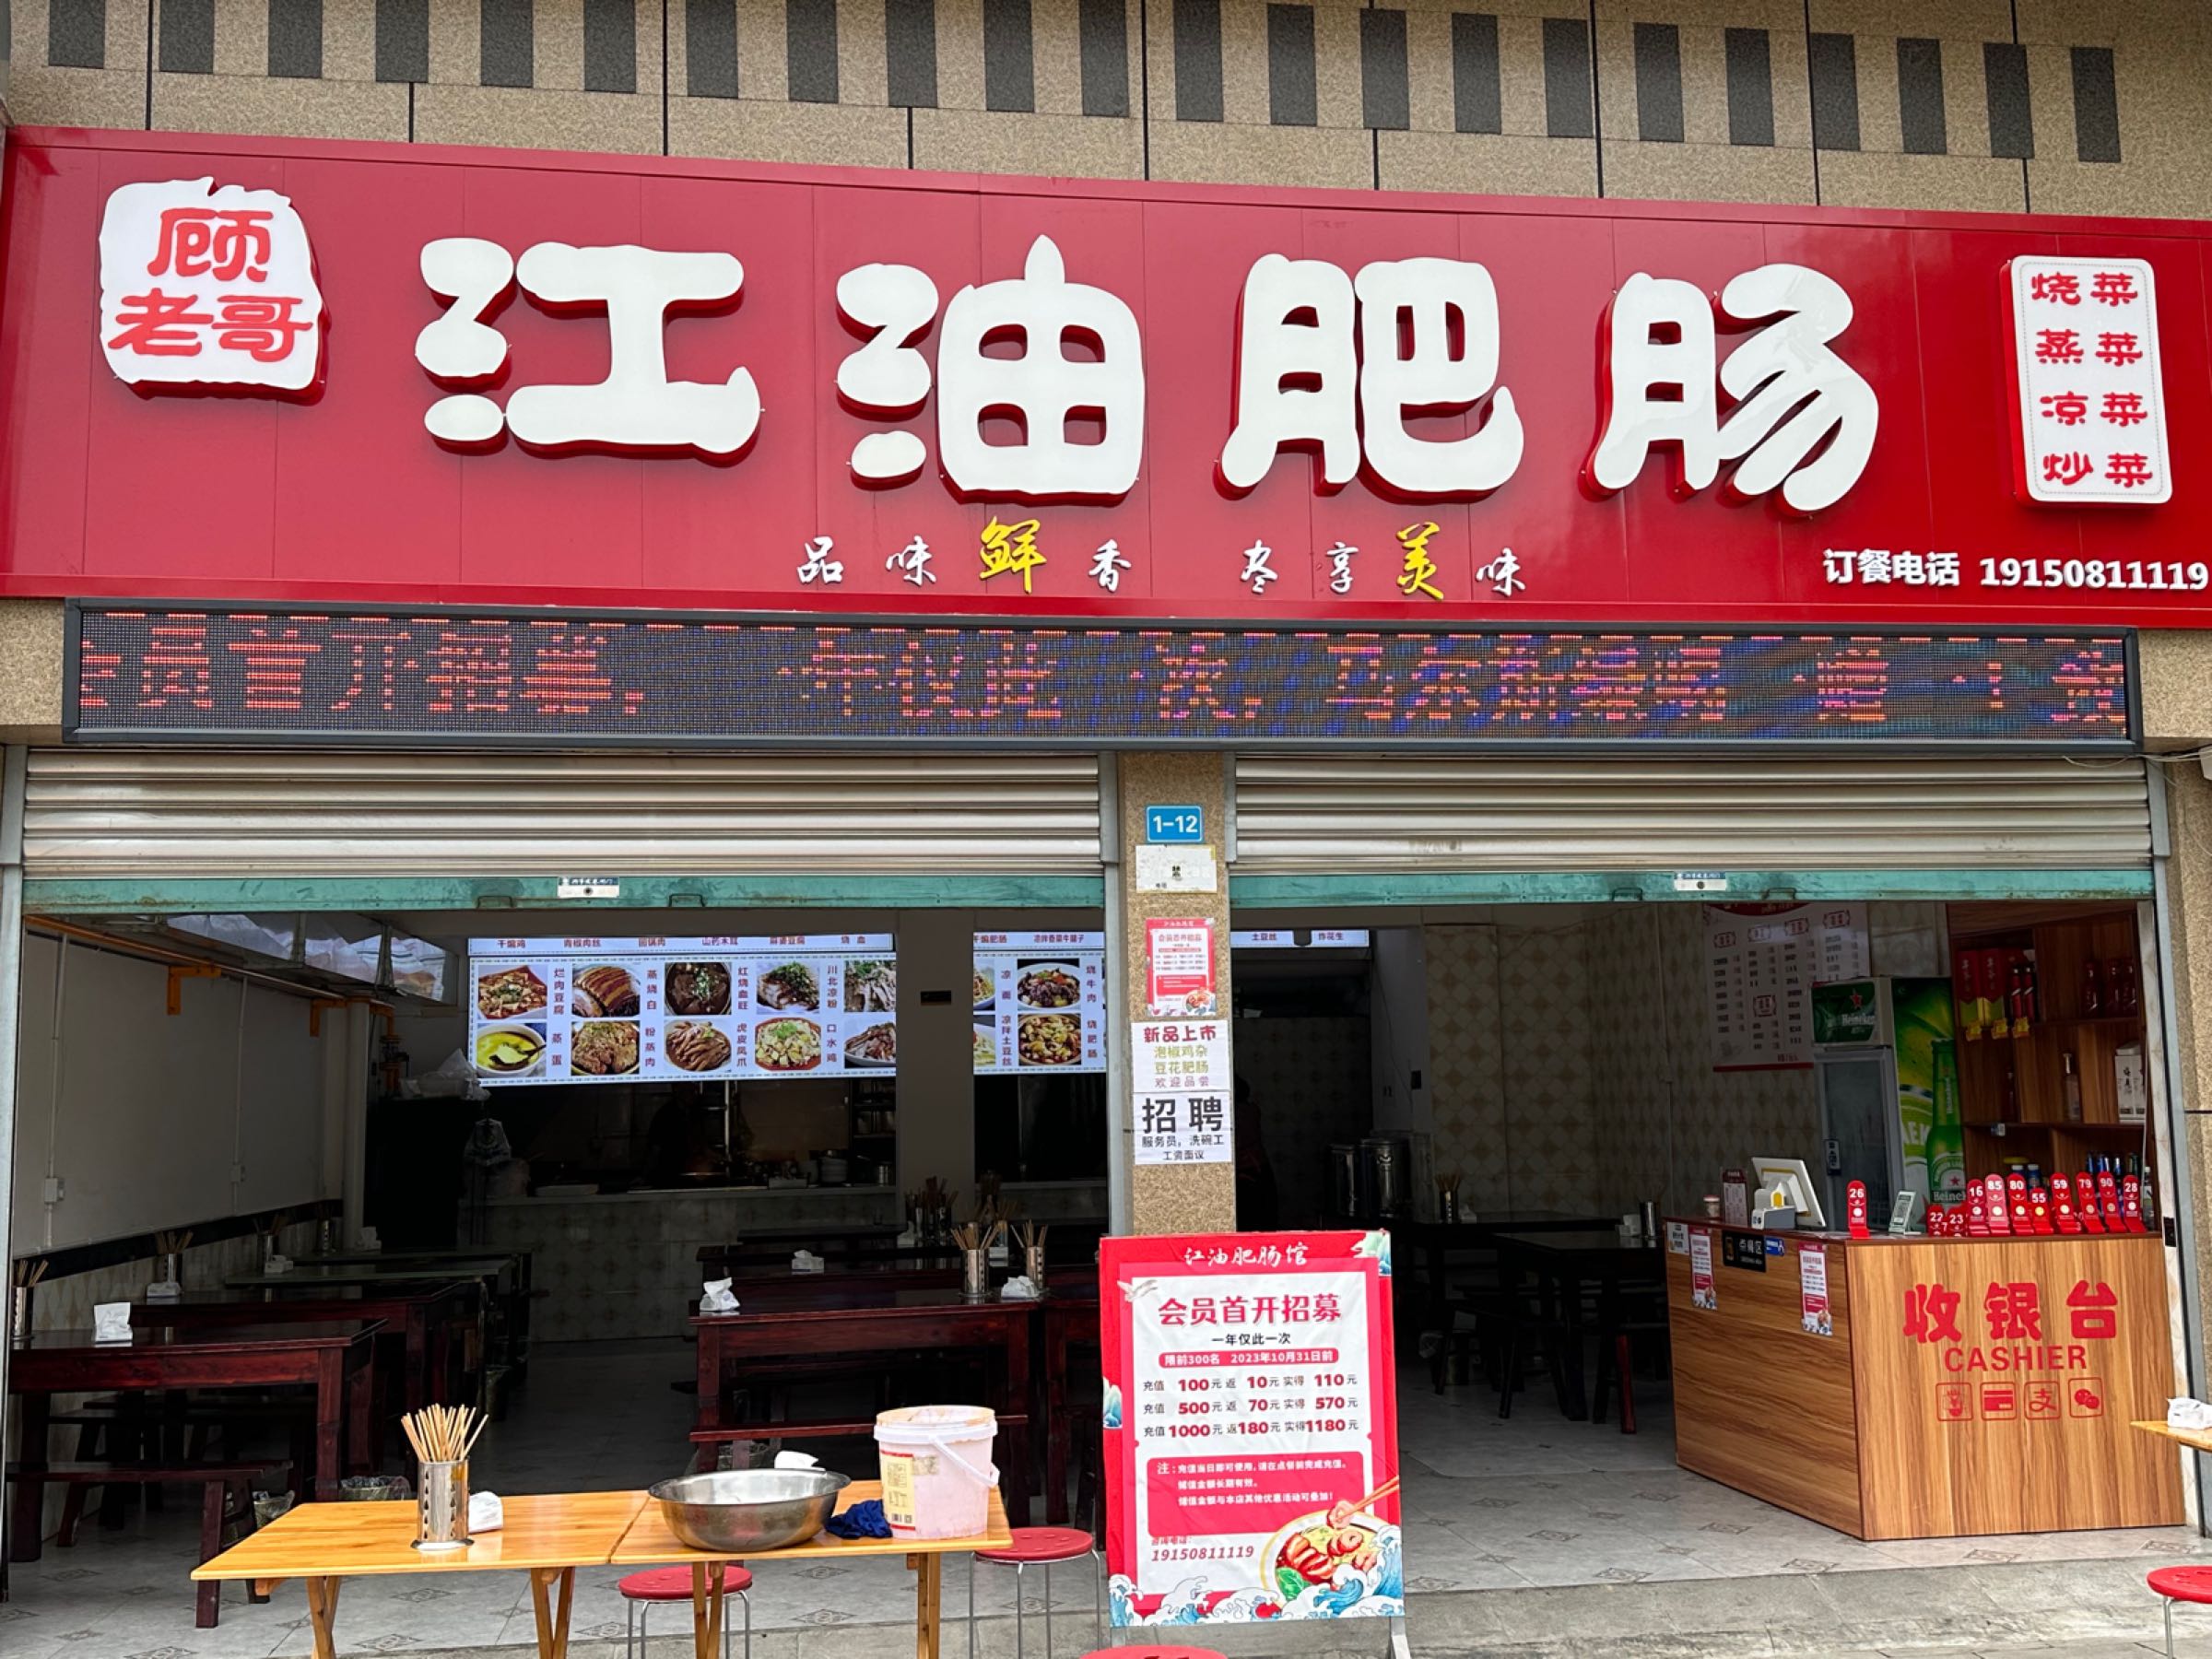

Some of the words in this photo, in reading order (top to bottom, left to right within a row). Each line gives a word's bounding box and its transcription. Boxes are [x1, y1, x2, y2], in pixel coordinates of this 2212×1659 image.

[147, 207, 274, 283] 顾
[2030, 272, 2138, 307] 烧菜
[107, 288, 313, 363] 老哥
[2035, 328, 2144, 367] 蒸菜
[415, 234, 1879, 512] 江油肥肠
[2040, 391, 2148, 428] 凉菜
[2042, 452, 2153, 488] 炒菜
[796, 515, 1132, 594] 品味鲜香
[1241, 522, 1526, 600] 尽享美味
[1823, 548, 1960, 586] 订餐电话
[1979, 558, 2209, 591] 19150811119
[1152, 815, 1198, 833] 1-12
[1143, 1025, 1217, 1043] 新品上市
[1153, 1044, 1208, 1059] 泡椒鸡杂
[1154, 1061, 1210, 1075] 豆花肥肠
[1141, 1095, 1224, 1135] 招聘
[1162, 1149, 1206, 1161] 工资面议
[1849, 1187, 1865, 1199] 26
[1969, 1185, 1983, 1197] 16
[2031, 1193, 2046, 1204] 55
[2124, 1182, 2137, 1193] 28
[1183, 1241, 1309, 1267] 江油肥肠馆
[1158, 1292, 1342, 1325] 会员首开招募
[1903, 1280, 2118, 1343] 收银台
[1211, 1332, 1291, 1346] 一年仅此一次
[1230, 1348, 1335, 1365] 2023年10月31日前
[1945, 1345, 2088, 1372] CASHIER
[1151, 1545, 1255, 1562] 19150811119
